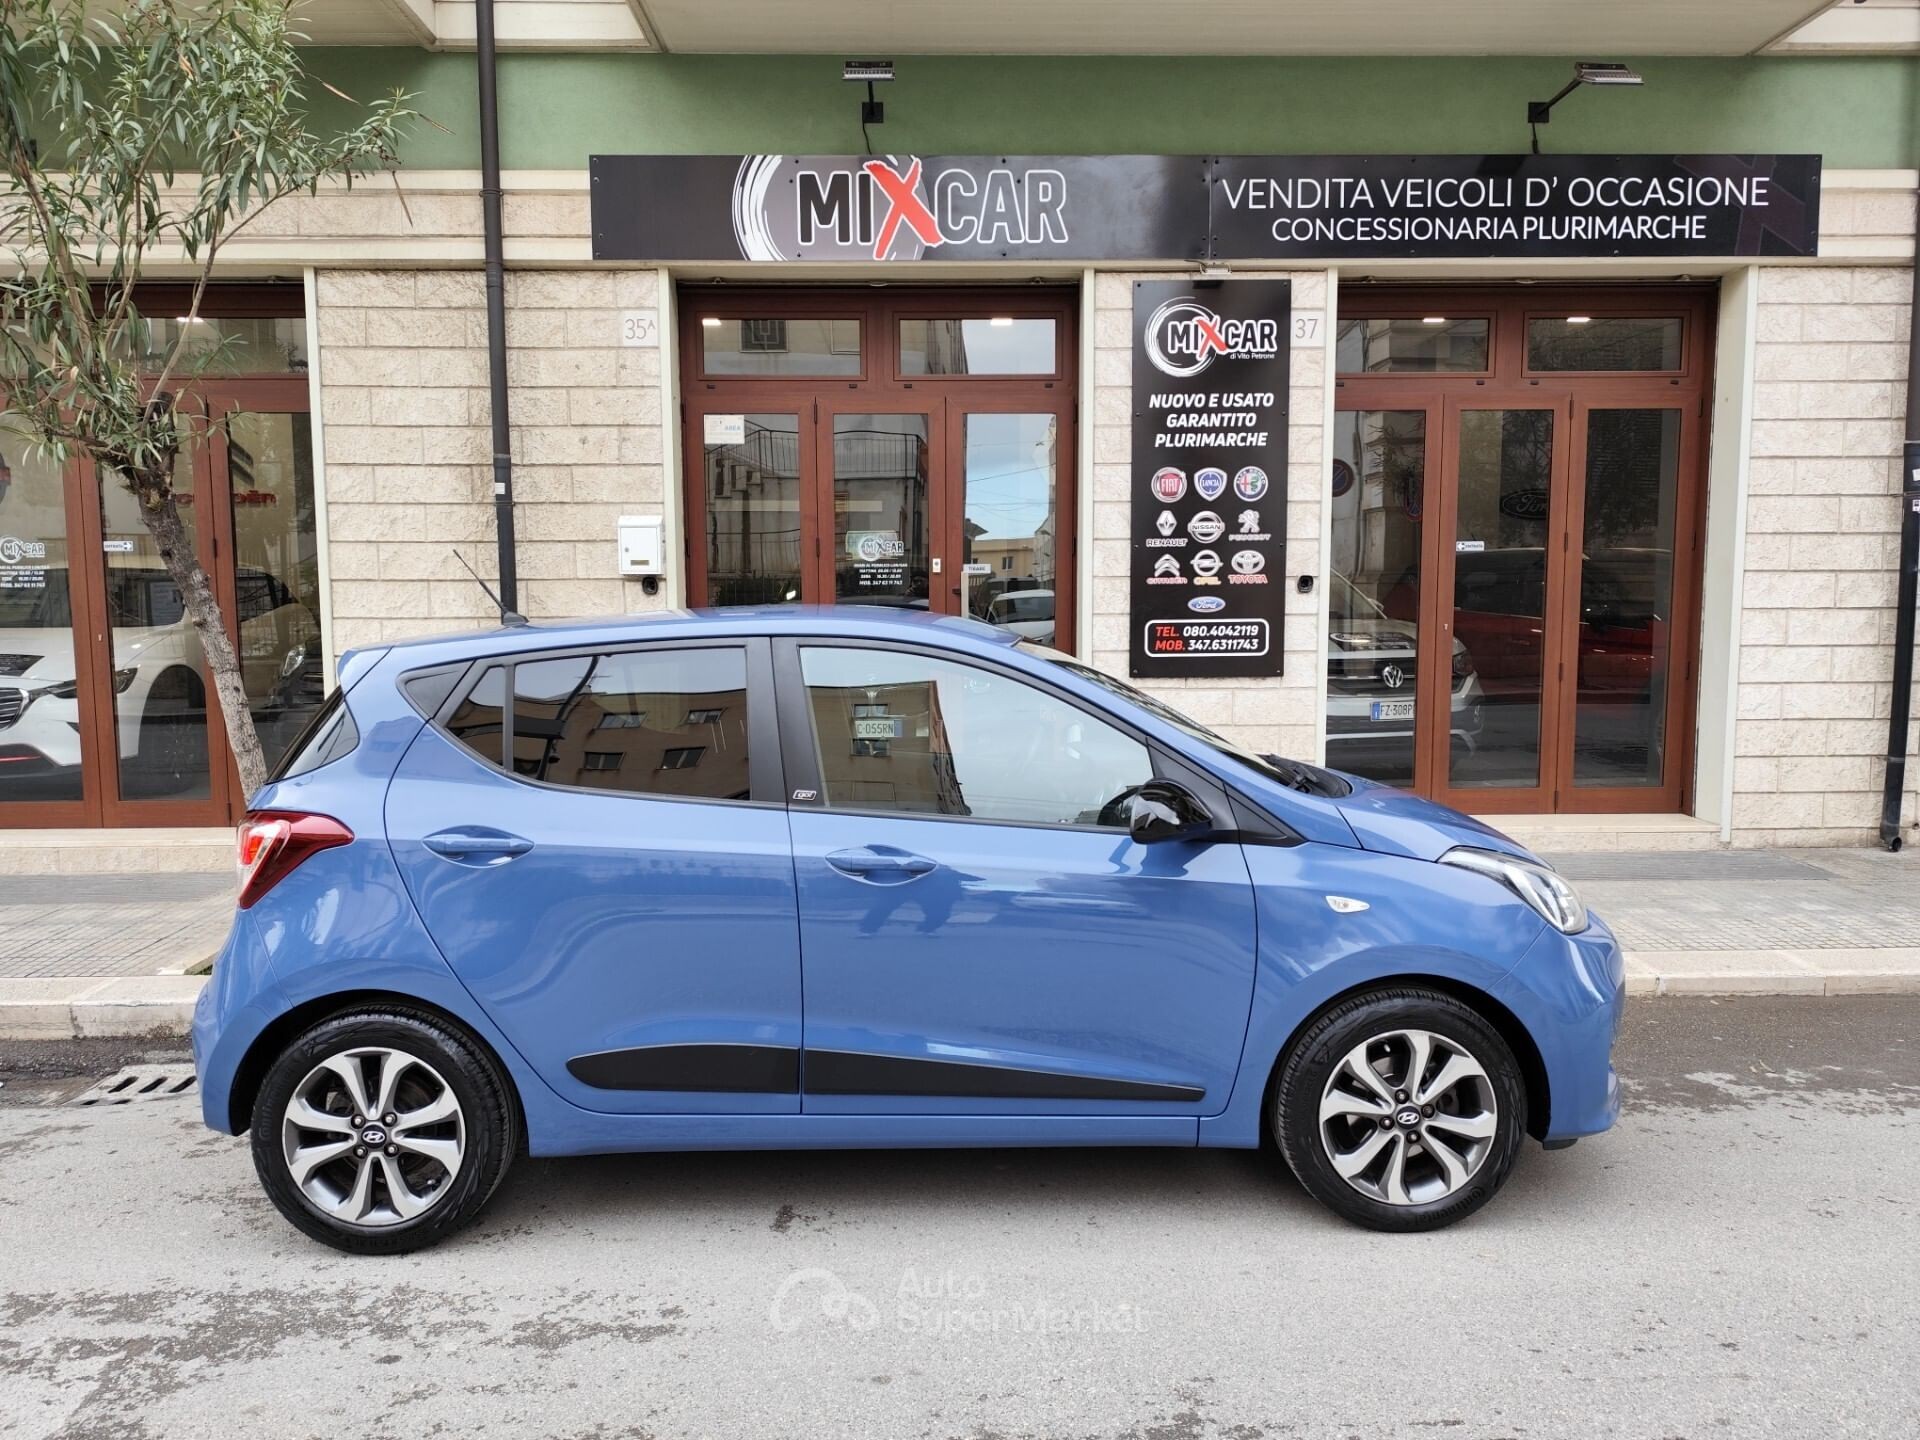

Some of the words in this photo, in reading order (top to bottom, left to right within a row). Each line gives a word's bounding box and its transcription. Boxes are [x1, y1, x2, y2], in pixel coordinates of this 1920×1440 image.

[1222, 178, 1374, 209] VENDITA
[1386, 177, 1513, 208] VEICOLI
[1567, 176, 1770, 207] OCCASIONE
[797, 158, 1068, 260] MIXCAR
[1271, 217, 1519, 242] CONCESSIONARIA
[1522, 215, 1707, 240] PLURIMARCHE
[1295, 318, 1318, 340] 37
[1167, 315, 1278, 361] MIXCAR
[1237, 352, 1250, 360] Vito
[1251, 352, 1275, 360] Petrone
[1149, 394, 1206, 409] NUOVO
[1208, 393, 1219, 408] E
[1221, 393, 1275, 407] USATO
[1166, 413, 1257, 428] GARANTITO
[1154, 432, 1268, 448] PLURIMARCHE
[1161, 478, 1178, 493] FIAT
[1201, 479, 1219, 487] LANCIA
[1146, 538, 1188, 548] RENAULT
[1228, 574, 1268, 584] TOYOTA
[1155, 626, 1180, 637] TEL.
[1183, 625, 1259, 637] 080.4042119
[1155, 640, 1186, 651] MOB.
[1187, 638, 1259, 651] 347.6311743
[1415, 1186, 1486, 1226] Continental
